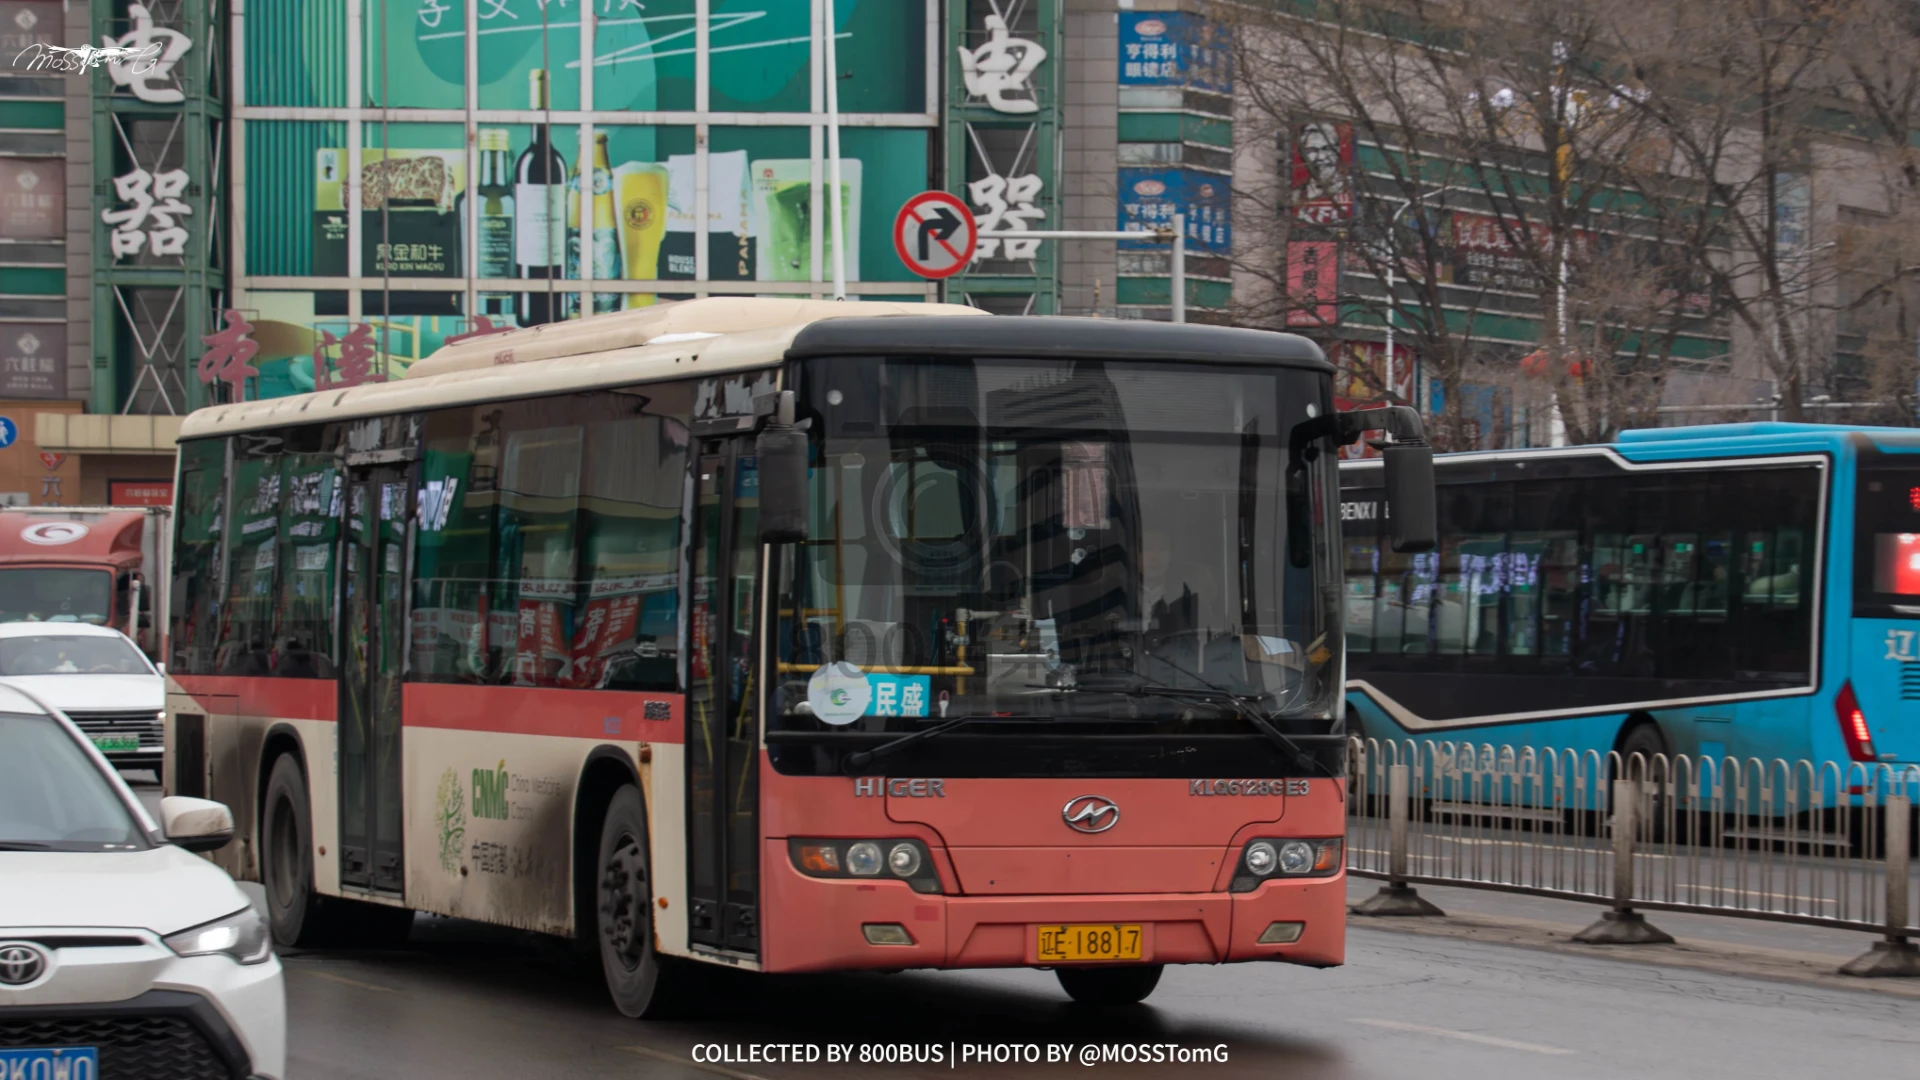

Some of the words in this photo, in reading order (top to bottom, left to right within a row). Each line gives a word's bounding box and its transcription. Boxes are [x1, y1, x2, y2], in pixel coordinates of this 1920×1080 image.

[102, 4, 193, 259] 电器
[957, 14, 1047, 262] 电器
[471, 759, 510, 821] CNMC
[855, 778, 946, 797] HIGER
[1189, 779, 1310, 796] KLQ6128GE3
